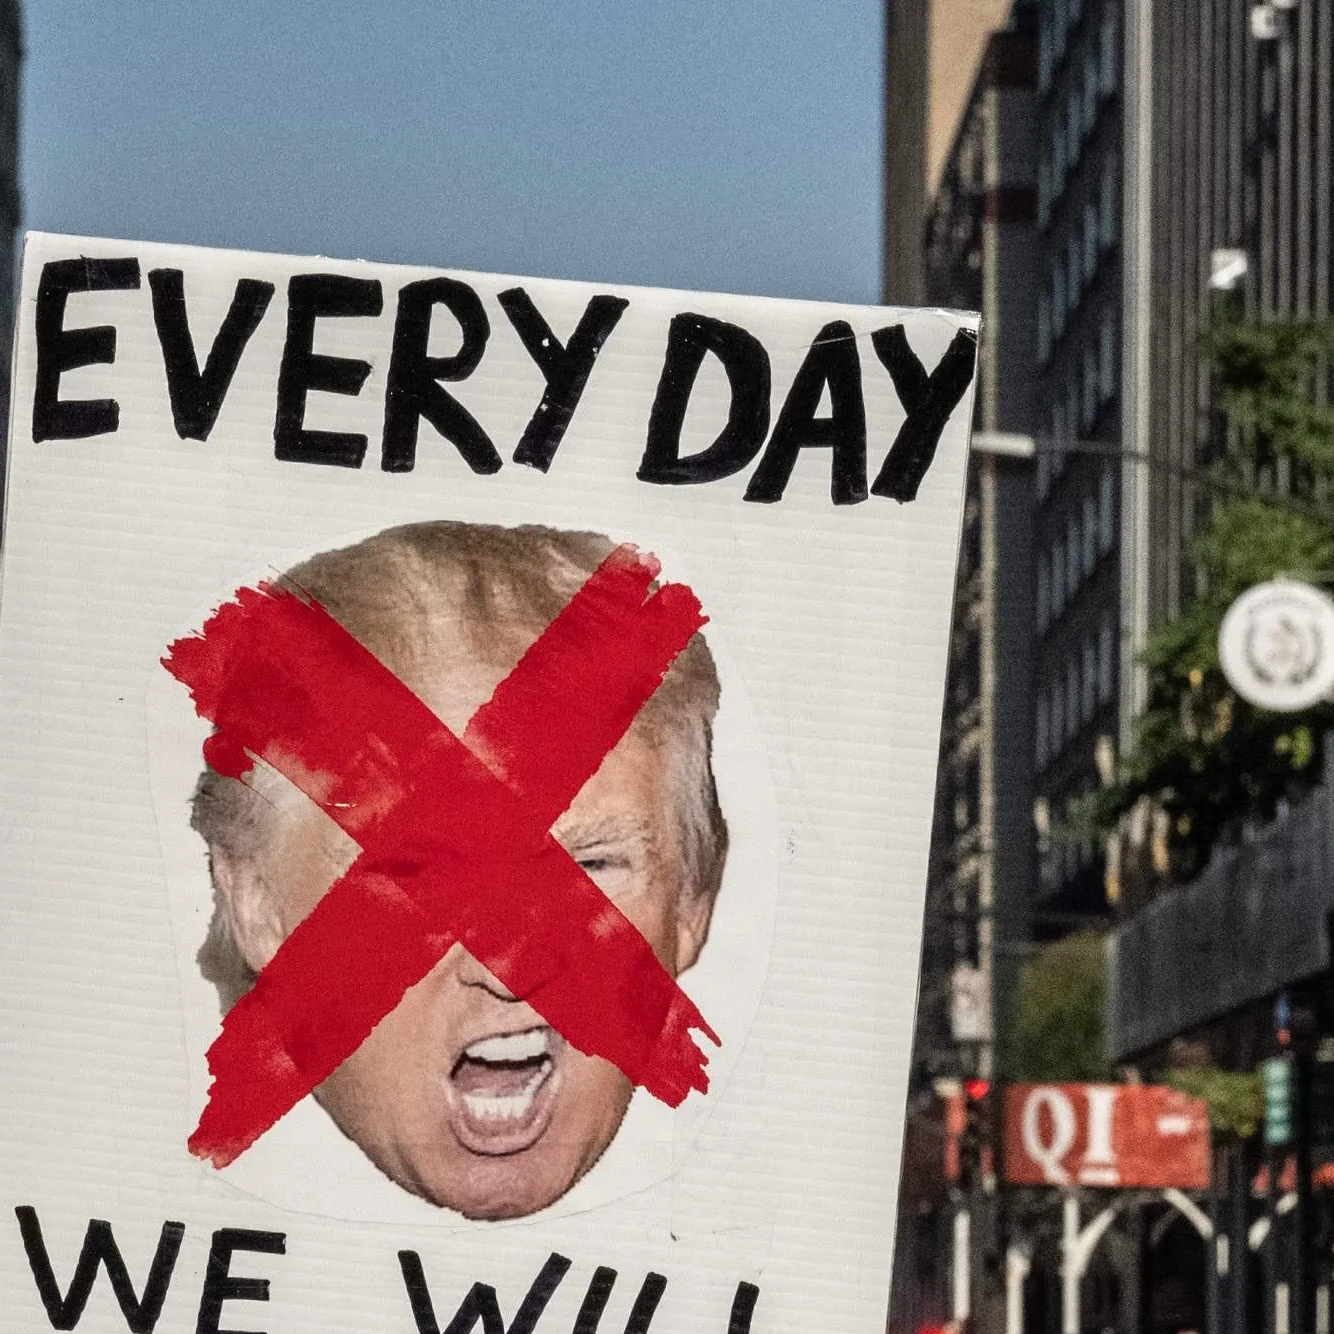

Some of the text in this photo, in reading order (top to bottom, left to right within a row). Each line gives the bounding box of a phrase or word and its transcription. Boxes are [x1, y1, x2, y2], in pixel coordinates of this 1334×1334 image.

[31, 254, 977, 505] EVERY DAY
[1020, 1085, 1122, 1185] QI
